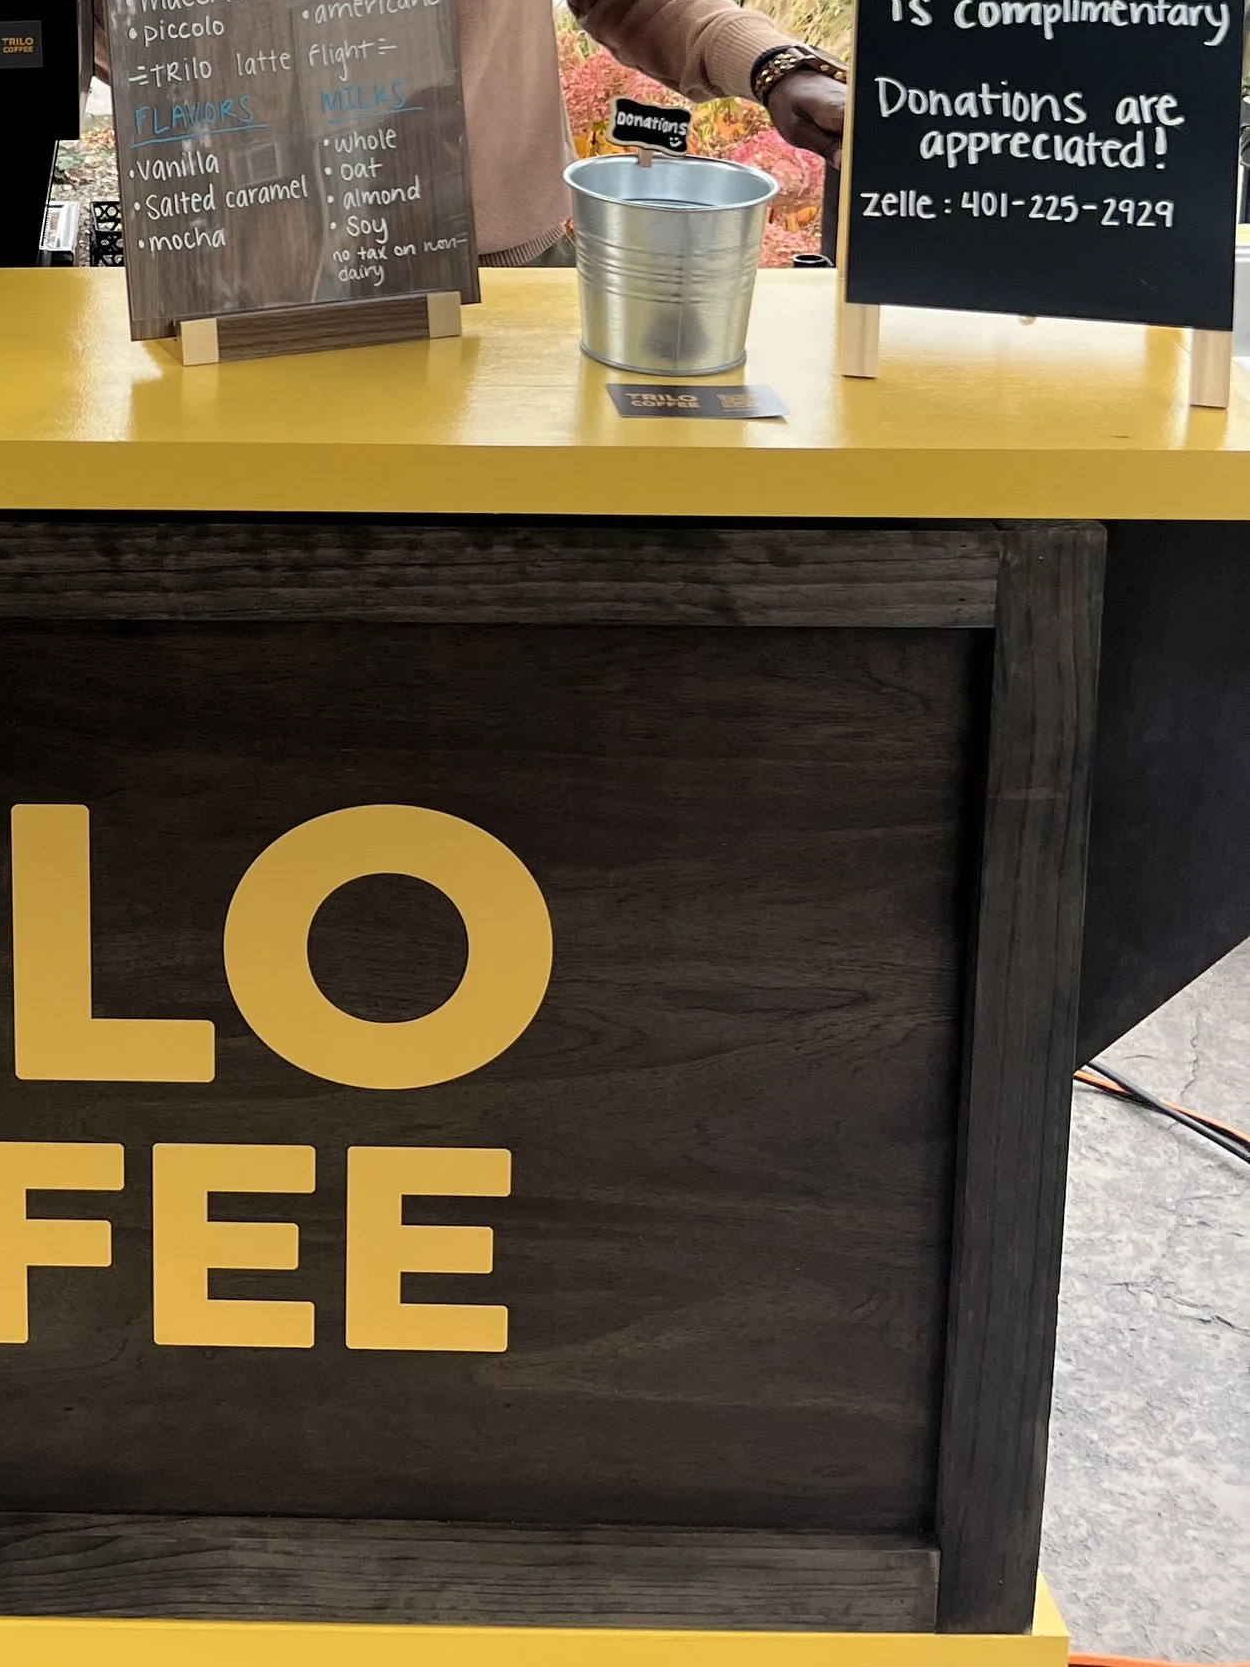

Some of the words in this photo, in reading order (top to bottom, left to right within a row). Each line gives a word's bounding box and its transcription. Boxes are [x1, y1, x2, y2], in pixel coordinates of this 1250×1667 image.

[1, 37, 34, 46] TRILO
[143, 16, 225, 47] piccolo
[2, 46, 34, 54] COFFEE
[236, 49, 291, 76] latte
[321, 82, 407, 113] MILKS
[874, 77, 1087, 124] Donations
[1115, 93, 1185, 127] are
[134, 94, 254, 135] FLAVORS
[617, 111, 688, 136] Donations
[334, 128, 397, 153] whole
[919, 126, 1169, 170] appreciated!
[340, 157, 383, 181] oat
[225, 174, 309, 209] caramel
[343, 174, 422, 210] almond
[961, 190, 1175, 228] 401-225-2929
[149, 226, 226, 252] mocha
[332, 249, 350, 263] no
[357, 246, 388, 261] tax
[393, 244, 417, 257] on
[338, 264, 386, 287] dairy
[625, 393, 698, 402] TRILO
[630, 400, 699, 409] COFFEE
